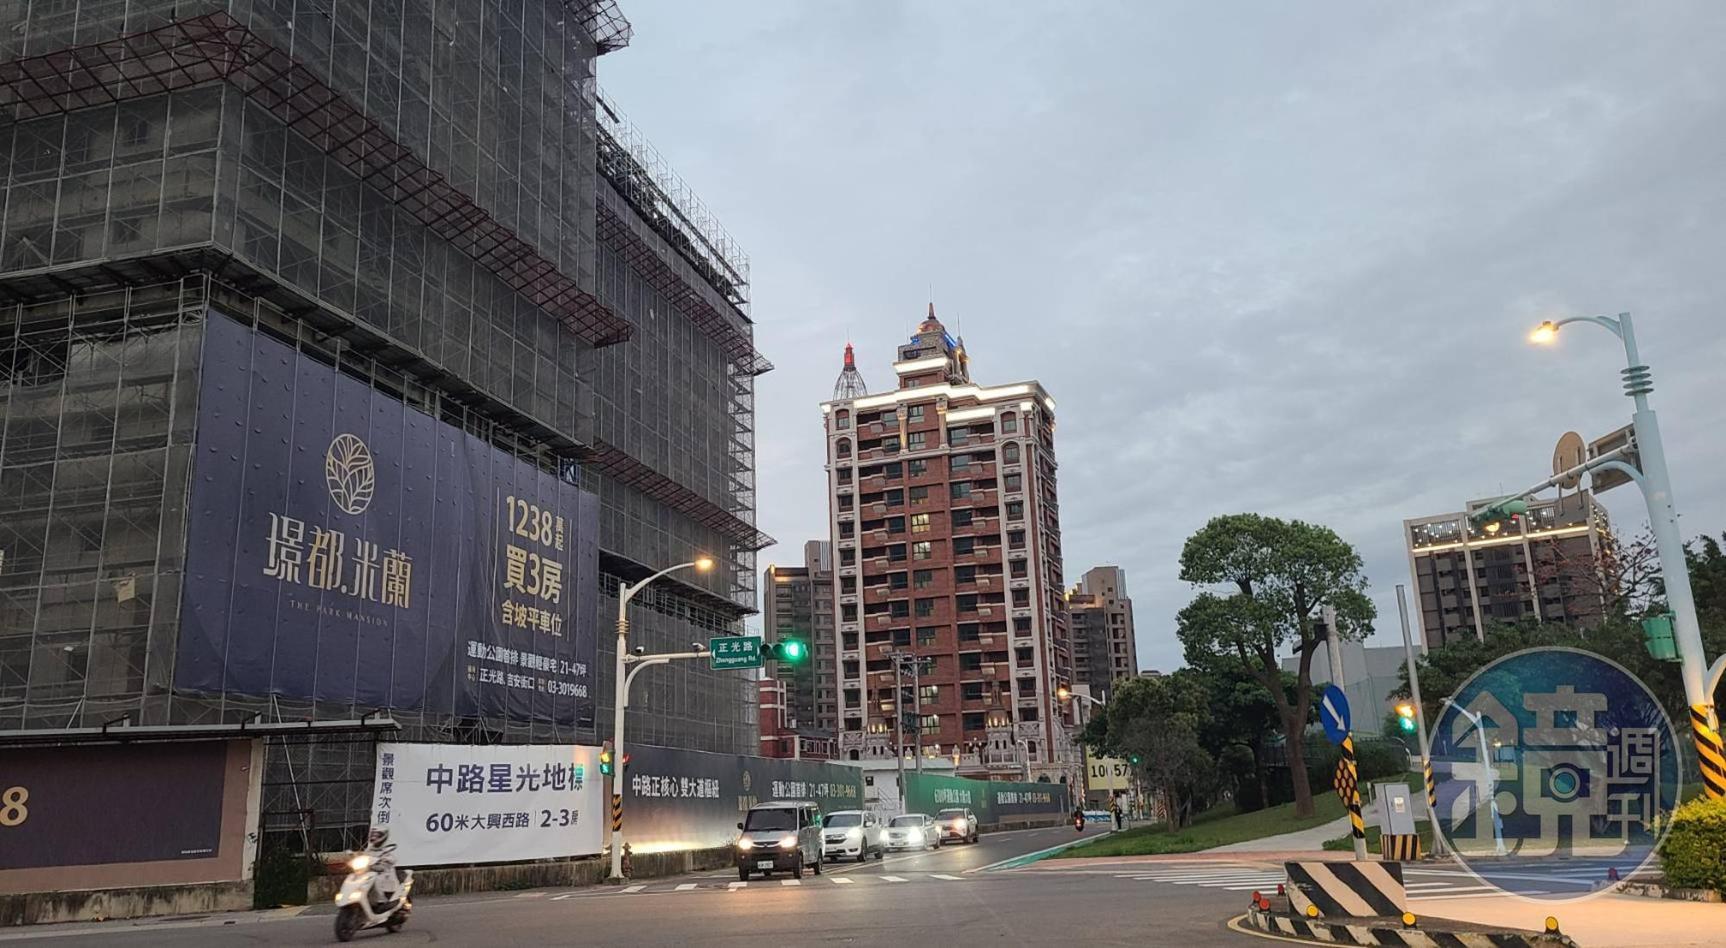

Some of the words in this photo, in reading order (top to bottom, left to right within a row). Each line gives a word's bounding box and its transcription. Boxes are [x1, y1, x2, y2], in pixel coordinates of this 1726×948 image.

[506, 495, 553, 546] 1238
[504, 543, 563, 604] 買3房
[290, 599, 311, 611] THE
[316, 606, 341, 617] PARK
[346, 610, 388, 626] MANSION
[501, 599, 563, 637] 含坡平車位
[718, 641, 753, 653] 正光路
[547, 679, 588, 698] 03-3019668
[377, 753, 394, 824] 景觀席次倒
[426, 763, 584, 794] 中路星光地標
[632, 774, 679, 797] 中路正核心
[0, 786, 29, 826] 8
[425, 812, 530, 832] 60米大興西路
